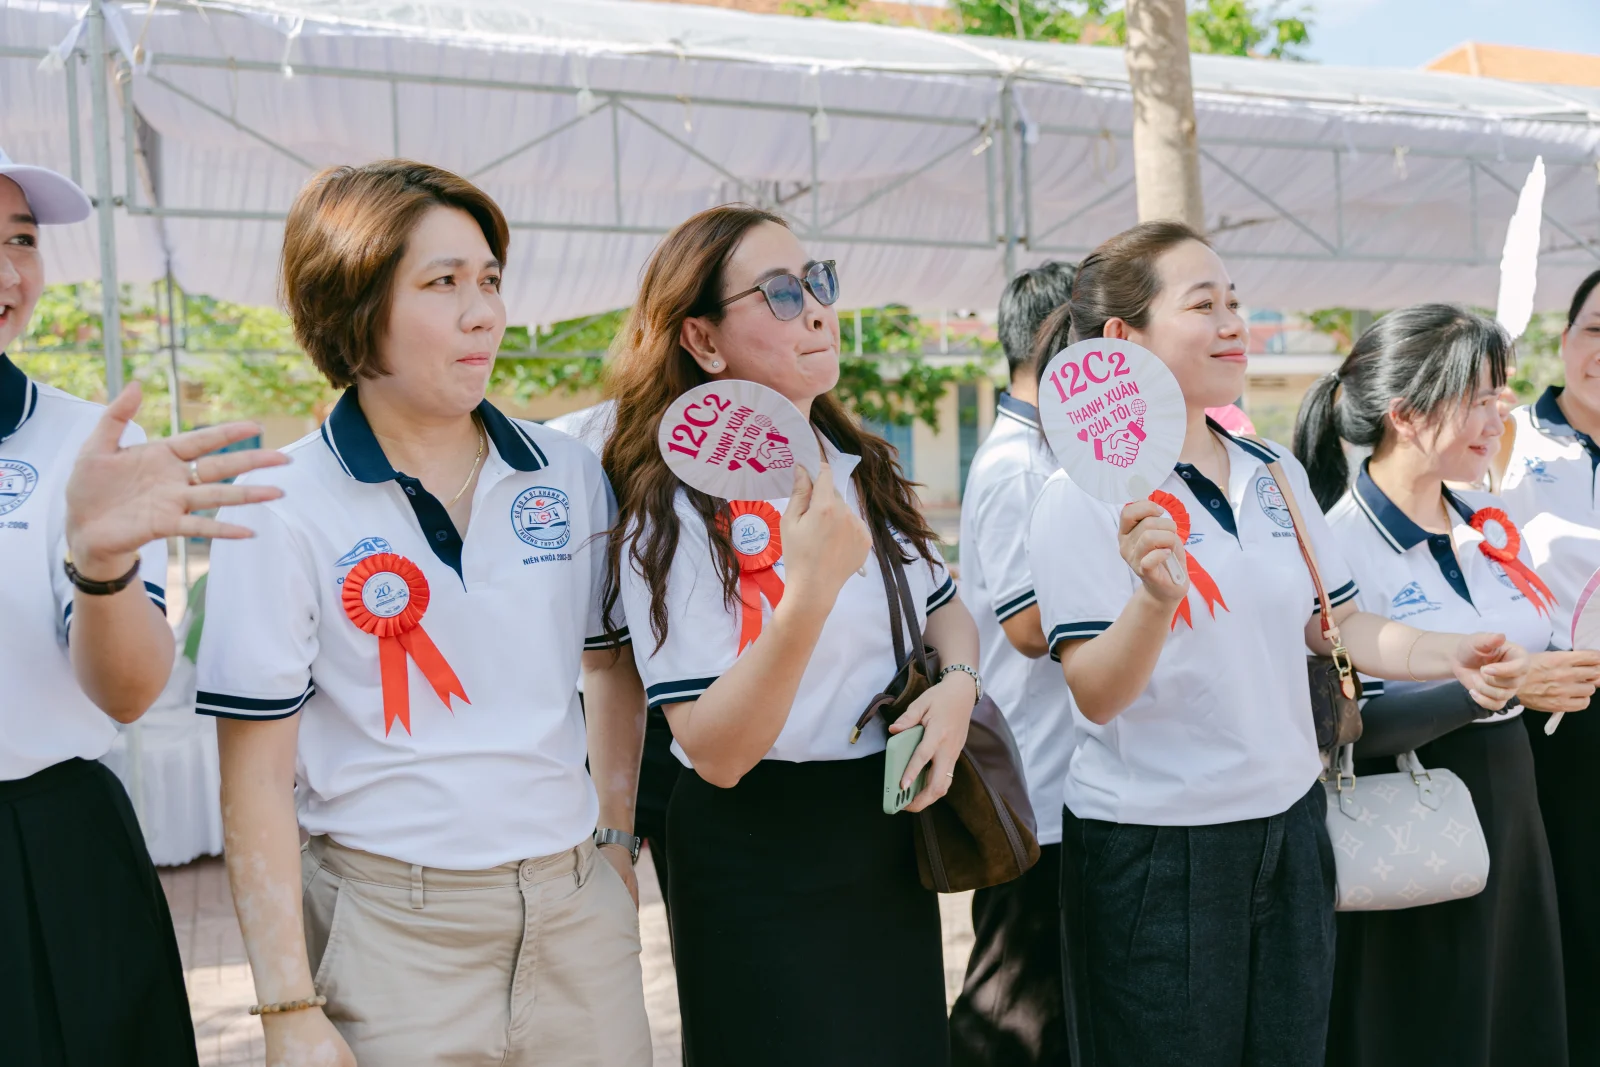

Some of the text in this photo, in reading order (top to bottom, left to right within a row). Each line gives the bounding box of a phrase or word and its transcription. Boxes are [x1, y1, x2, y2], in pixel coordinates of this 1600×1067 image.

[1049, 351, 1130, 404] 12C2
[1066, 380, 1140, 425] THANH XUÂN
[1088, 403, 1131, 438] CỦA TÔI
[667, 393, 732, 460] 12C2
[706, 405, 755, 465] THANH XUÂN
[732, 424, 763, 461] CỦA TÔI
[741, 525, 756, 538] 20
[522, 555, 540, 565] NIÊN
[539, 552, 556, 562] KHÓA
[374, 584, 391, 600] 20
